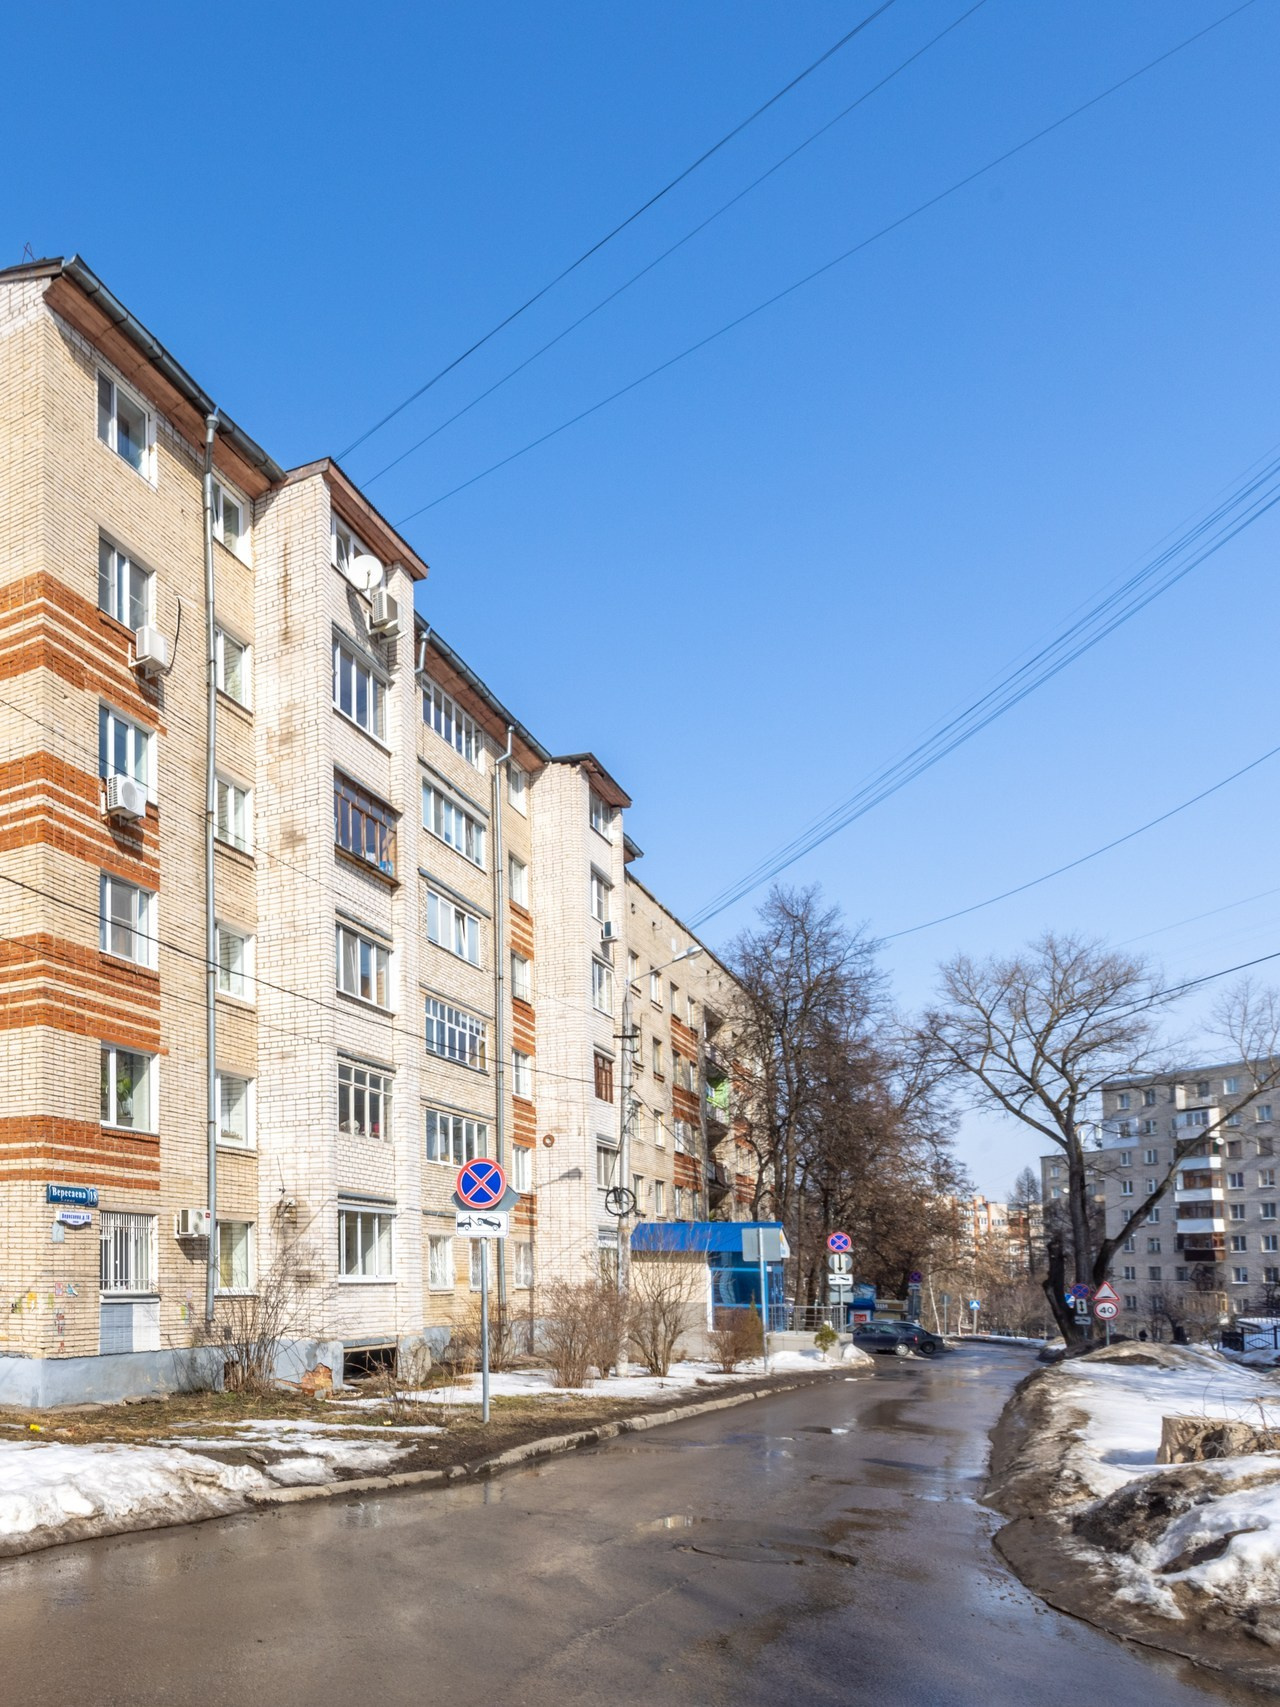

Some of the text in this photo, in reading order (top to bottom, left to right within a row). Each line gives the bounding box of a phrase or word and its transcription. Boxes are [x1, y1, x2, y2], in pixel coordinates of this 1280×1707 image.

[51, 1186, 98, 1202] Вересаева 18
[1099, 1306, 1114, 1314] 40
